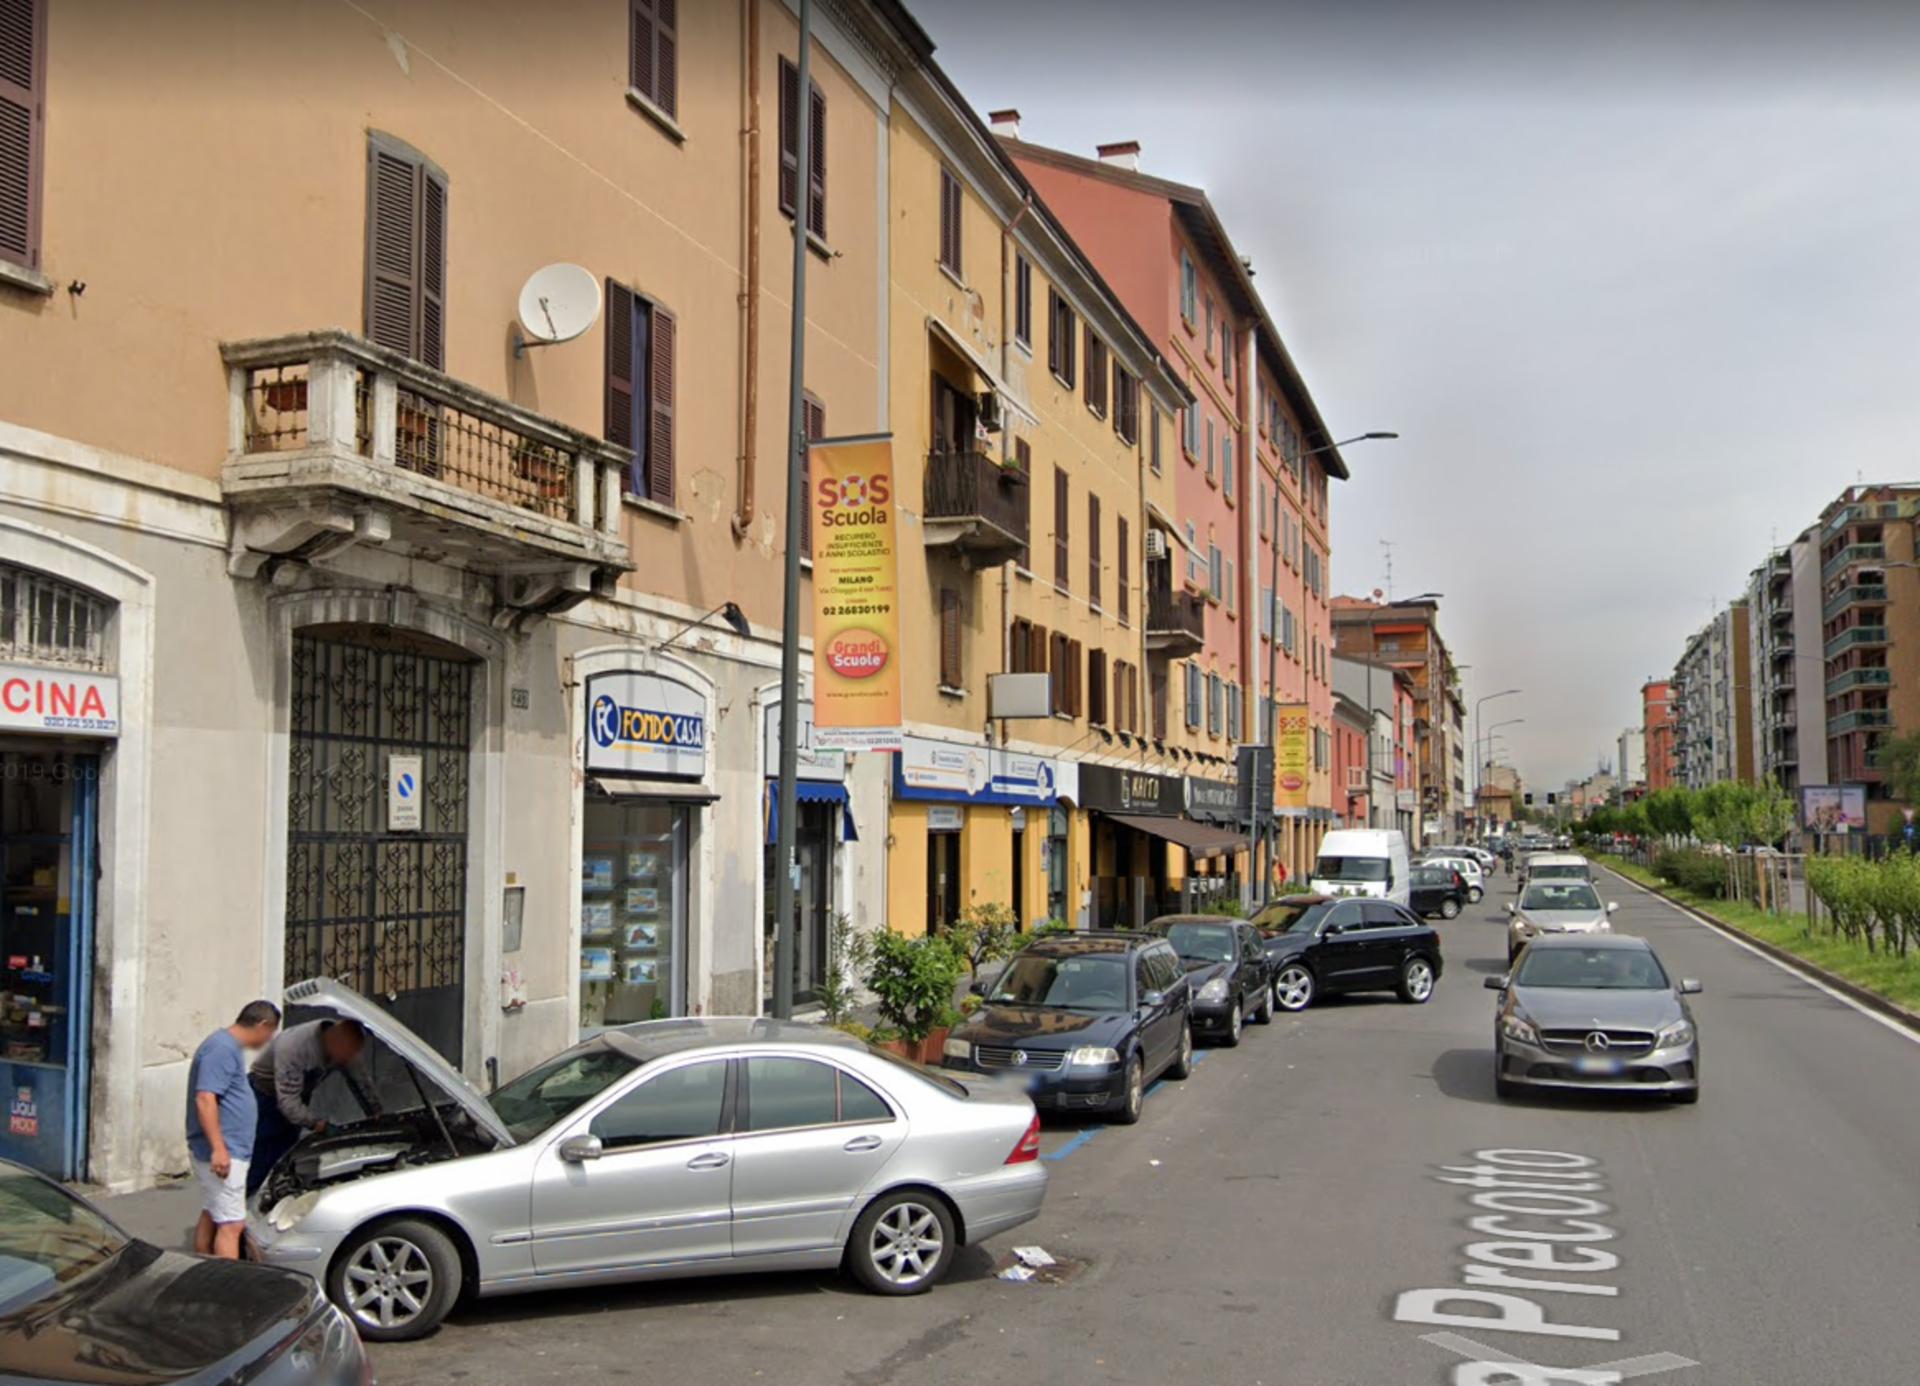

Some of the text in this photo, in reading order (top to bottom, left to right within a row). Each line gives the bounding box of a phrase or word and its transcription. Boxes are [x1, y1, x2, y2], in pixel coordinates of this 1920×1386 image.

[818, 473, 890, 508] SOS
[822, 507, 887, 527] Scuola
[834, 531, 877, 541] RECUPERO
[825, 550, 846, 559] ANNI
[838, 575, 874, 585] MILANO
[822, 605, 836, 616] 02
[834, 640, 881, 654] Grandi
[834, 653, 881, 667] Scuole
[2, 677, 107, 719] CINA
[622, 708, 702, 746] FONDOCASA
[11, 1101, 37, 1117] LIQUI
[10, 1116, 38, 1134] MOLY
